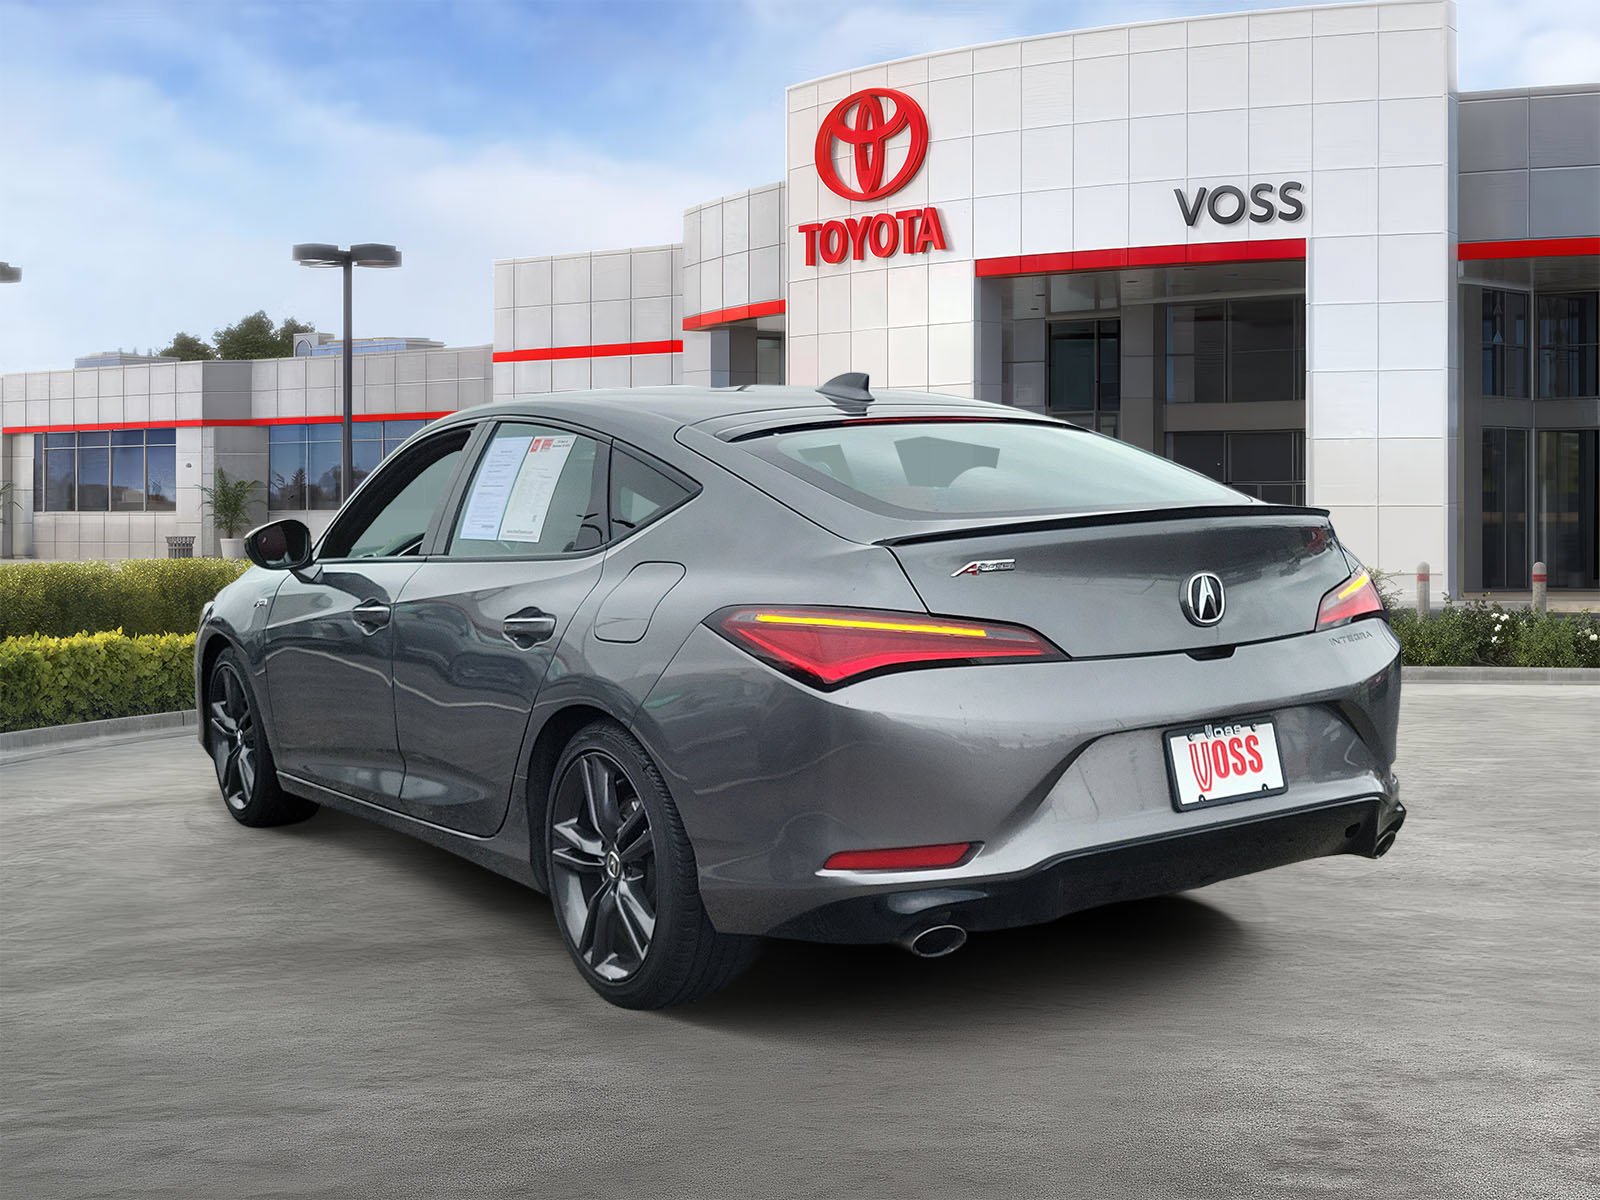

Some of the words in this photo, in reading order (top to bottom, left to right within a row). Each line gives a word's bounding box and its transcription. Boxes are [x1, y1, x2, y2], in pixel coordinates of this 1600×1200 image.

[1173, 181, 1304, 226] VOSS
[798, 207, 947, 266] TOYOTA
[1188, 734, 1264, 792] VOSS
